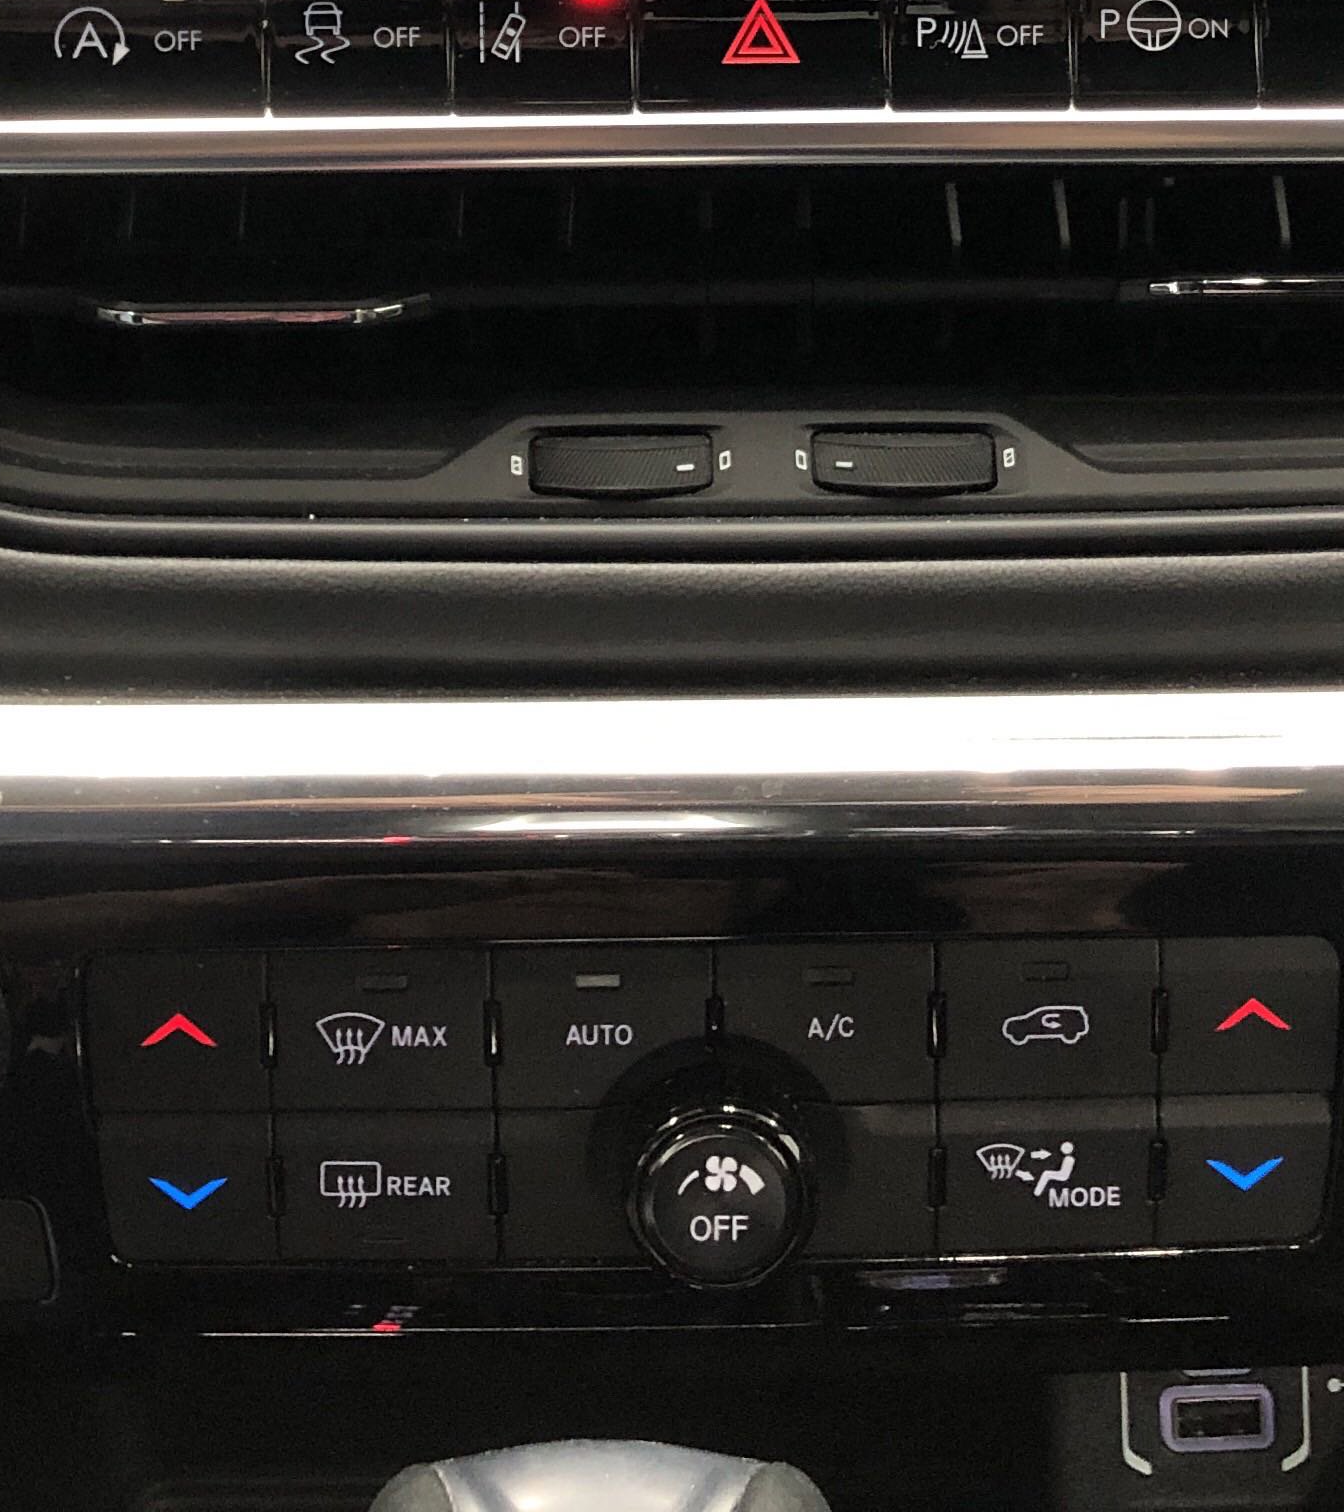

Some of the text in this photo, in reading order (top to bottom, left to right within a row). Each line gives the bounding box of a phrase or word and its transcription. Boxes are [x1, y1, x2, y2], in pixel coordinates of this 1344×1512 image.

[373, 27, 420, 48] OFF
[558, 26, 606, 48] OFF
[997, 24, 1044, 46] OFF
[1188, 18, 1228, 40] ON
[154, 30, 202, 52] OFF
[392, 1026, 447, 1047] MAX
[566, 1024, 633, 1046] AUTO
[808, 1015, 854, 1040] A/C
[386, 1176, 450, 1197] REAR
[1048, 1187, 1120, 1207] MODE
[690, 1216, 748, 1242] OFF
